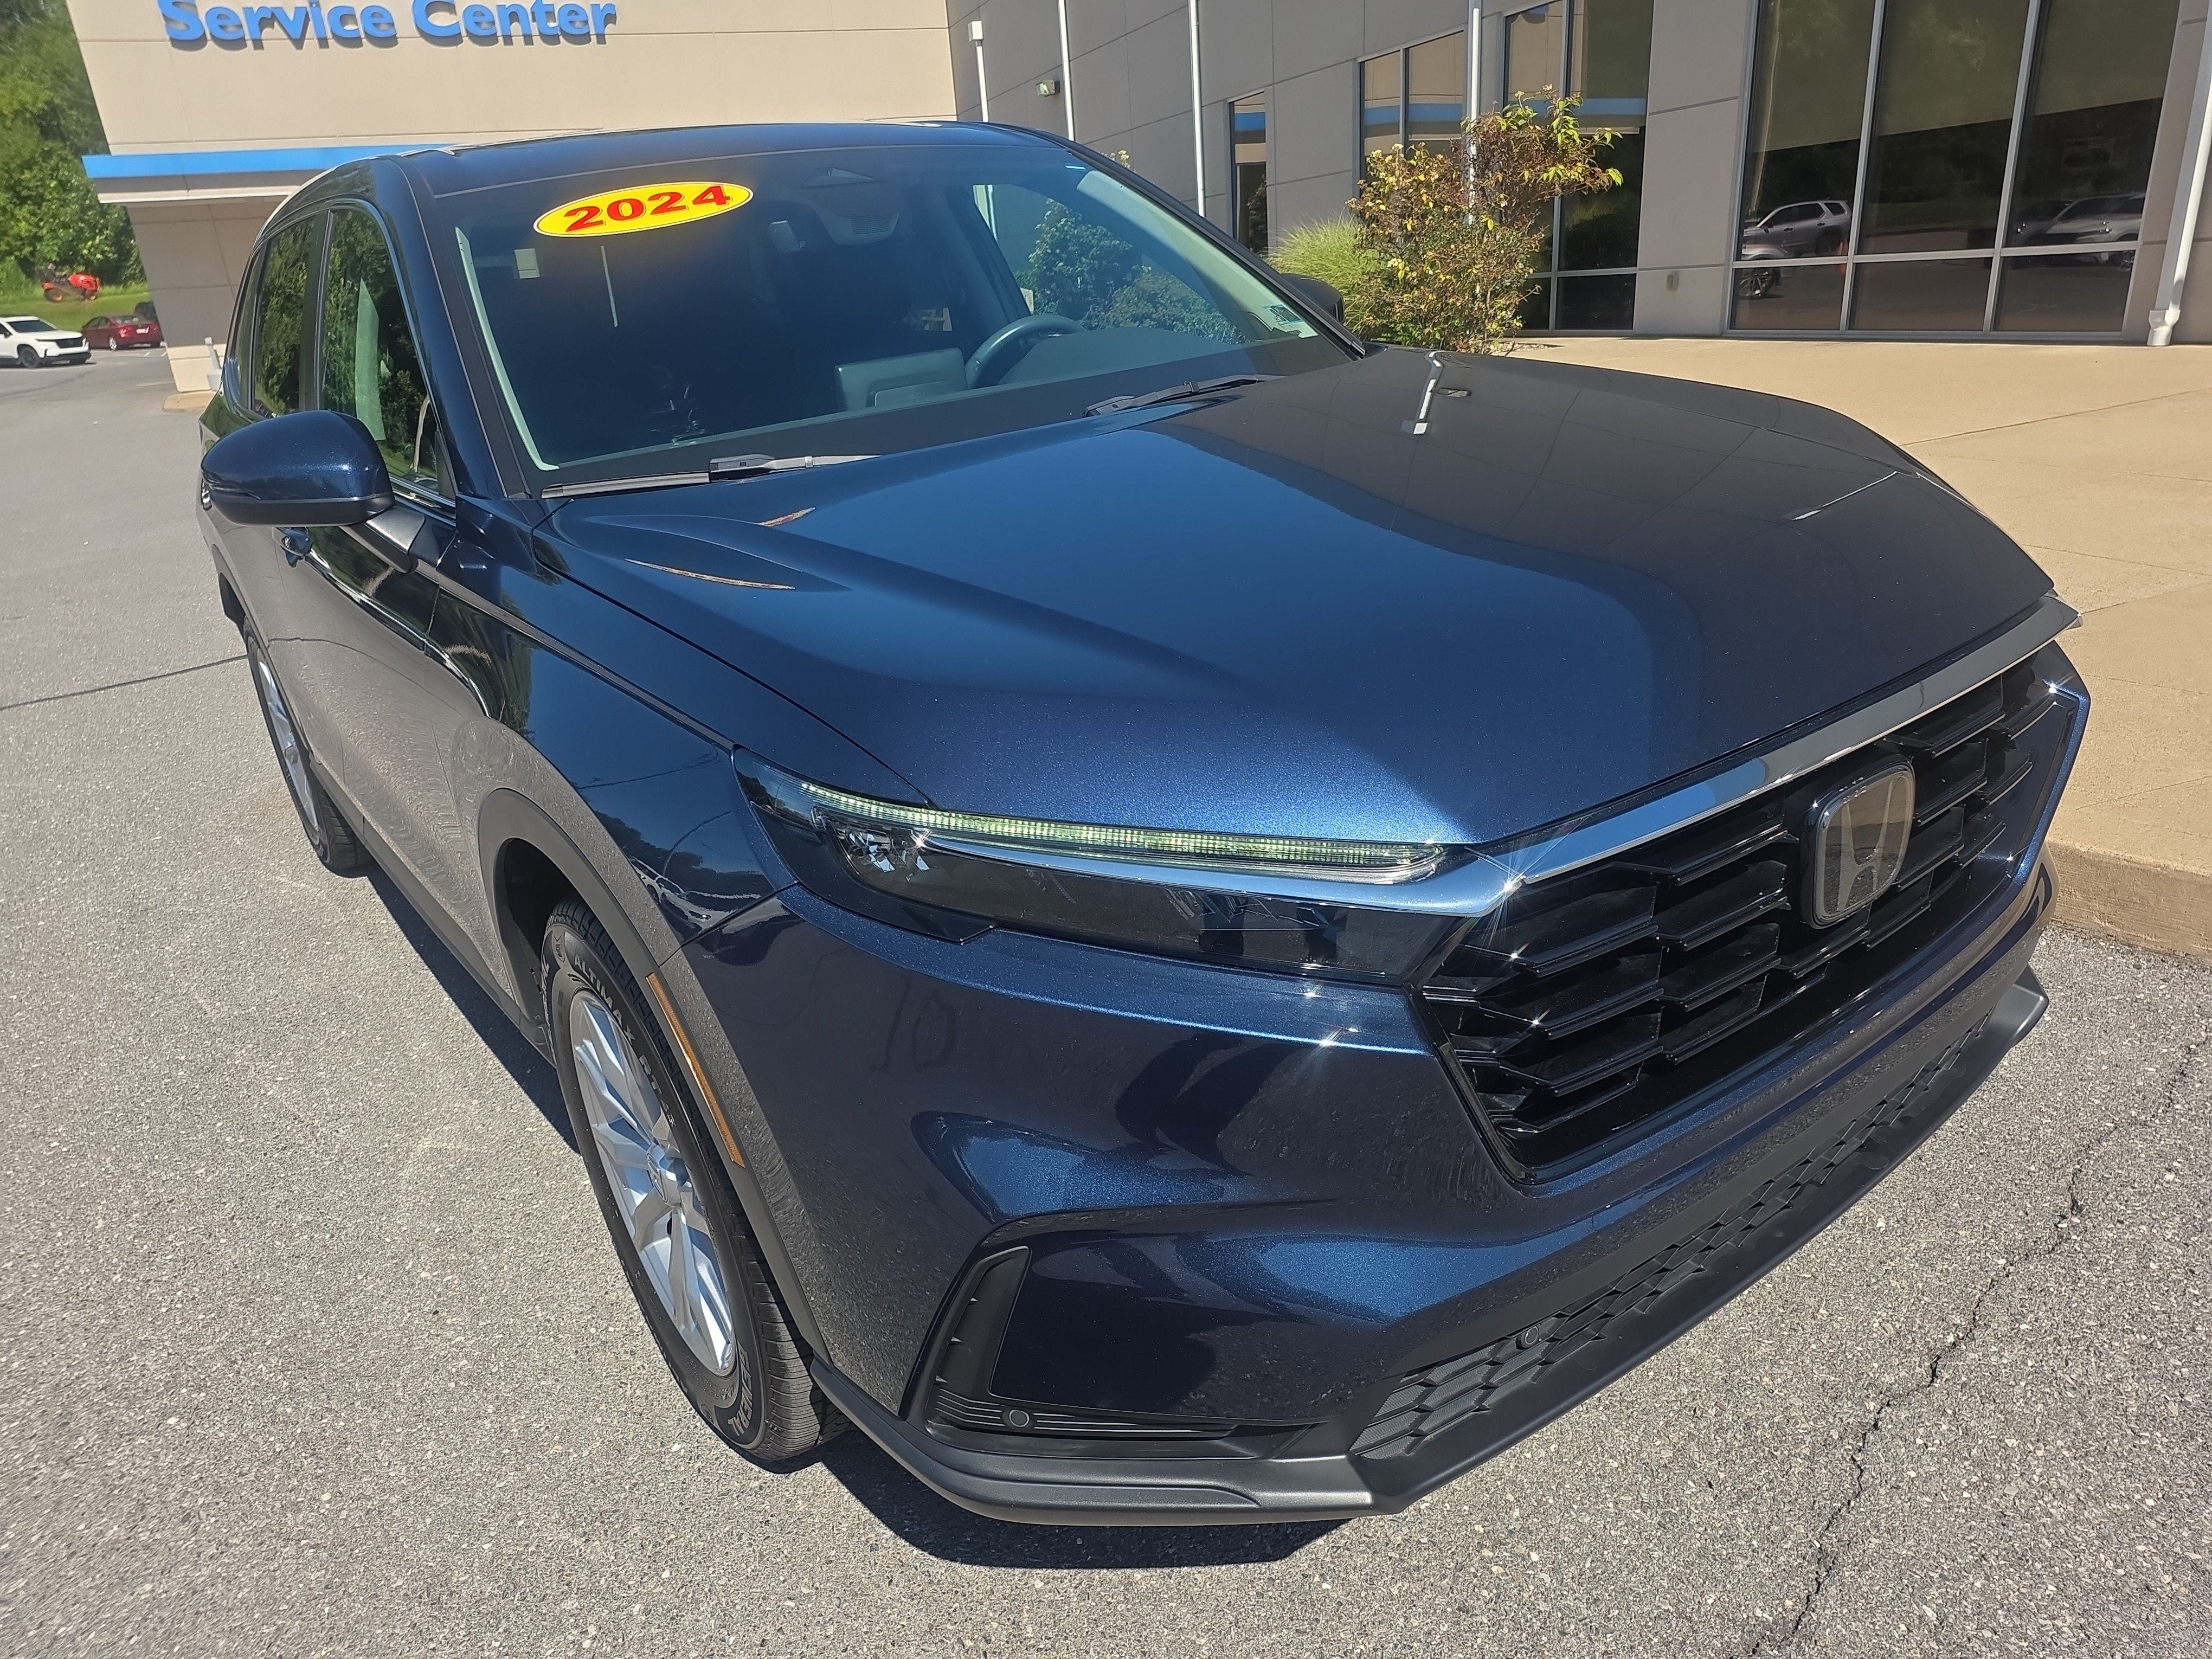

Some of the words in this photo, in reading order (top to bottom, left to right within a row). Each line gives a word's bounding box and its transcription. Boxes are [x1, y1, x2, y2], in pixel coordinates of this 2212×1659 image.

[156, 0, 394, 40] Service
[412, 0, 616, 37] Center
[564, 185, 733, 232] 2024
[575, 955, 635, 1044] ALTIMAX
[728, 1340, 753, 1436] GENERAL
